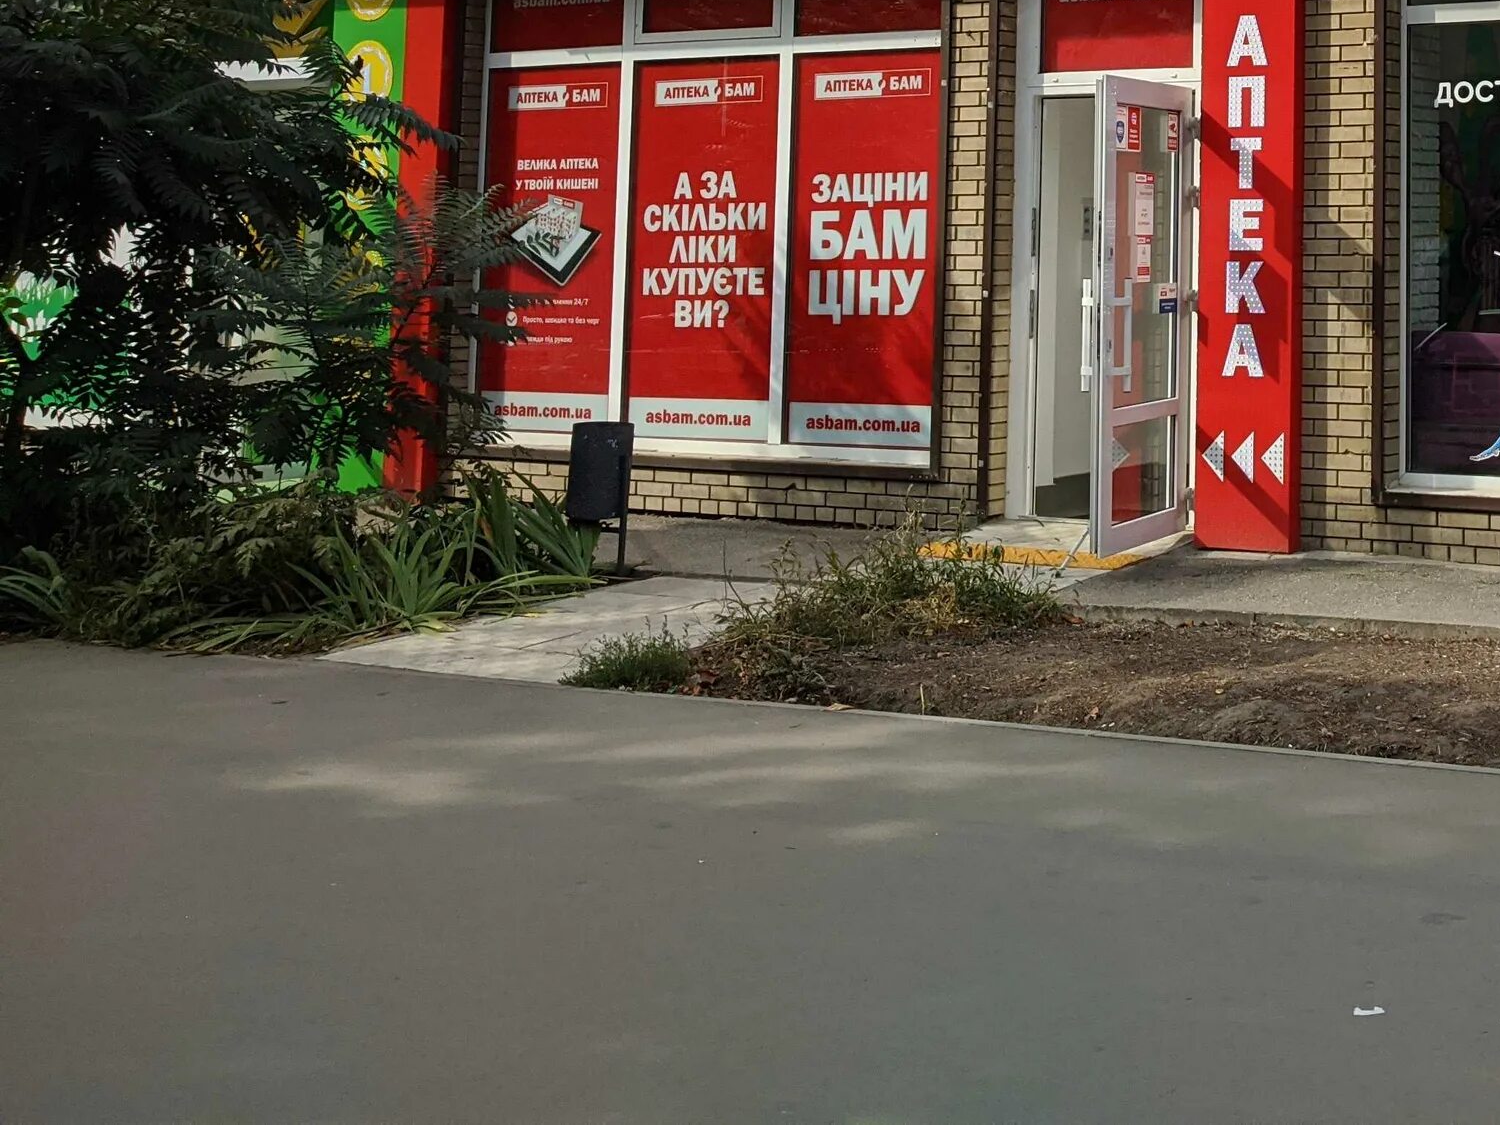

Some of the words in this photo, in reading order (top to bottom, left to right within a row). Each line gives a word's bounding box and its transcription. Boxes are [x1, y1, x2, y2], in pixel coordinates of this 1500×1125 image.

[516, 91, 559, 104] АПТЕКА
[572, 88, 601, 103] БАМ
[663, 84, 710, 100] АПТЕКА
[724, 82, 755, 98] БАМ
[824, 77, 874, 94] АПТЕКА
[889, 75, 923, 91] БАМ
[517, 159, 557, 170] ВЕЛИКА
[559, 158, 599, 170] АПТЕКА
[515, 179, 523, 190] У
[524, 176, 554, 190] ТВОЇЙ
[556, 178, 599, 190] КИШЕНІ
[673, 172, 693, 200] А
[699, 170, 738, 200] ЗА
[811, 171, 929, 208] ЗАЦІНИ
[1221, 14, 1269, 378] АПТЕКА
[643, 202, 767, 232] СКІЛЬКИ
[668, 234, 737, 263] ЛІКИ
[809, 208, 928, 261] БАМ
[642, 266, 765, 297] КУПУЄТЕ
[807, 269, 926, 325] ЦІНУ
[674, 299, 730, 328] ВИ?
[494, 402, 592, 420] asbam.com.ua
[645, 409, 752, 427] asbam.com.ua
[805, 415, 921, 433] asbam.com.ua
